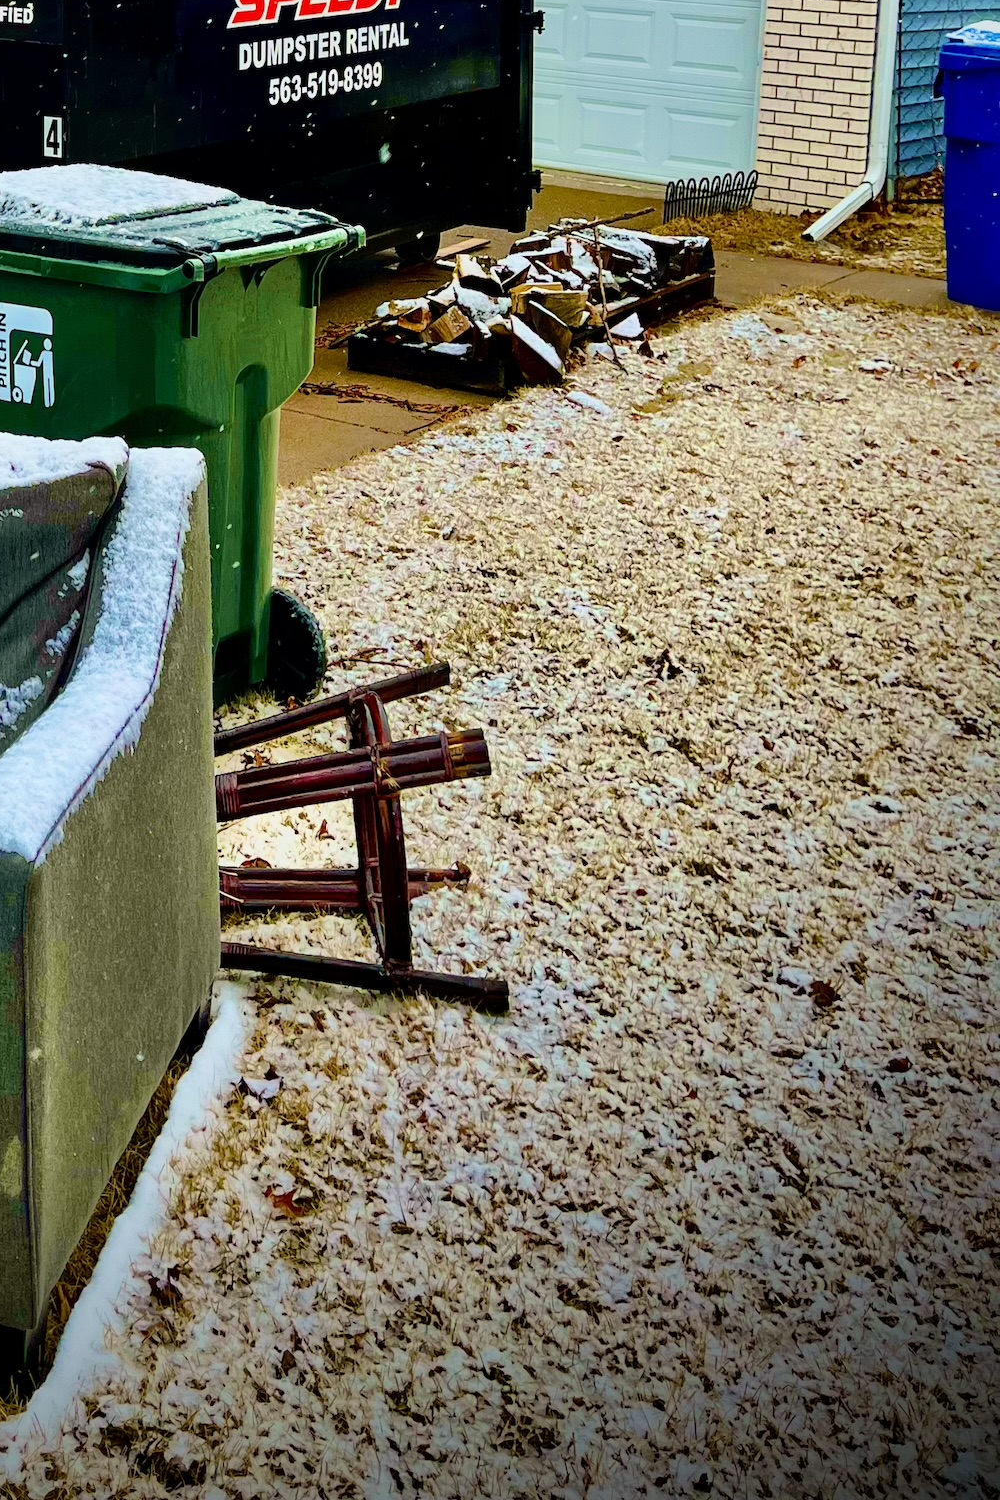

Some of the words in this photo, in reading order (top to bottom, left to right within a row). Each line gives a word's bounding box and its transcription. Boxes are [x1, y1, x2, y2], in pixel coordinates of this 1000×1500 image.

[239, 30, 341, 71] DUMPSTER
[345, 22, 409, 53] RENTAL
[268, 62, 383, 105] 563-519-8399
[46, 119, 60, 155] 4
